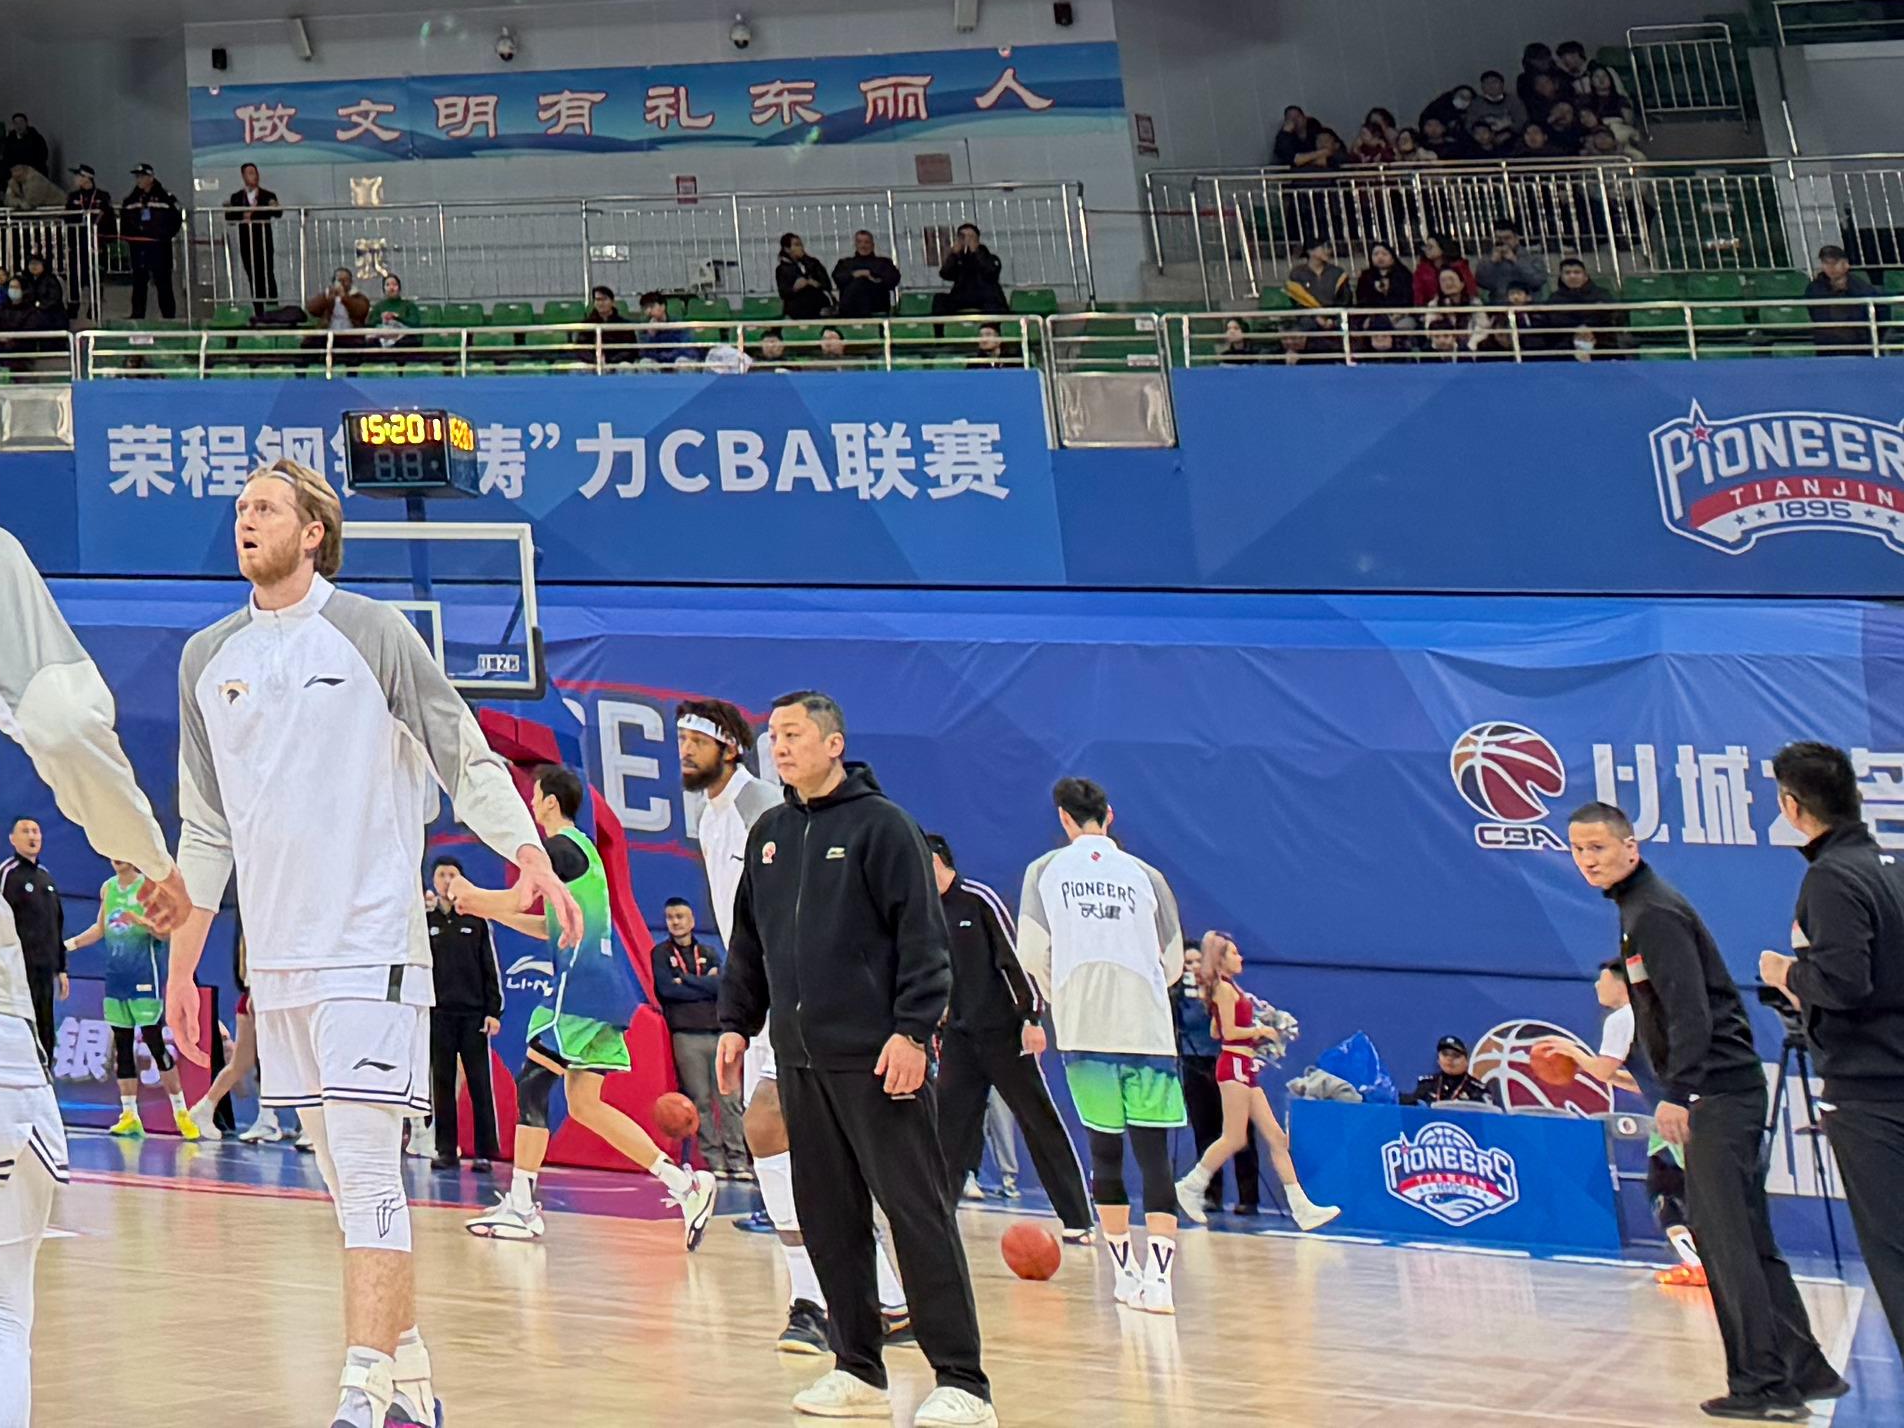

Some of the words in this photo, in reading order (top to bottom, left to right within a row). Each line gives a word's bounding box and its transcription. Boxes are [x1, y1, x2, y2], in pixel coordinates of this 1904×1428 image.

[234, 65, 1055, 146] 做文明有礼东丽人
[1660, 420, 1904, 520] PIONEER
[1729, 478, 1894, 507] TIANJIN
[1775, 500, 1852, 520] 1895
[1062, 880, 1136, 915] PIONEERS
[1386, 1143, 1513, 1194] PIONEERS
